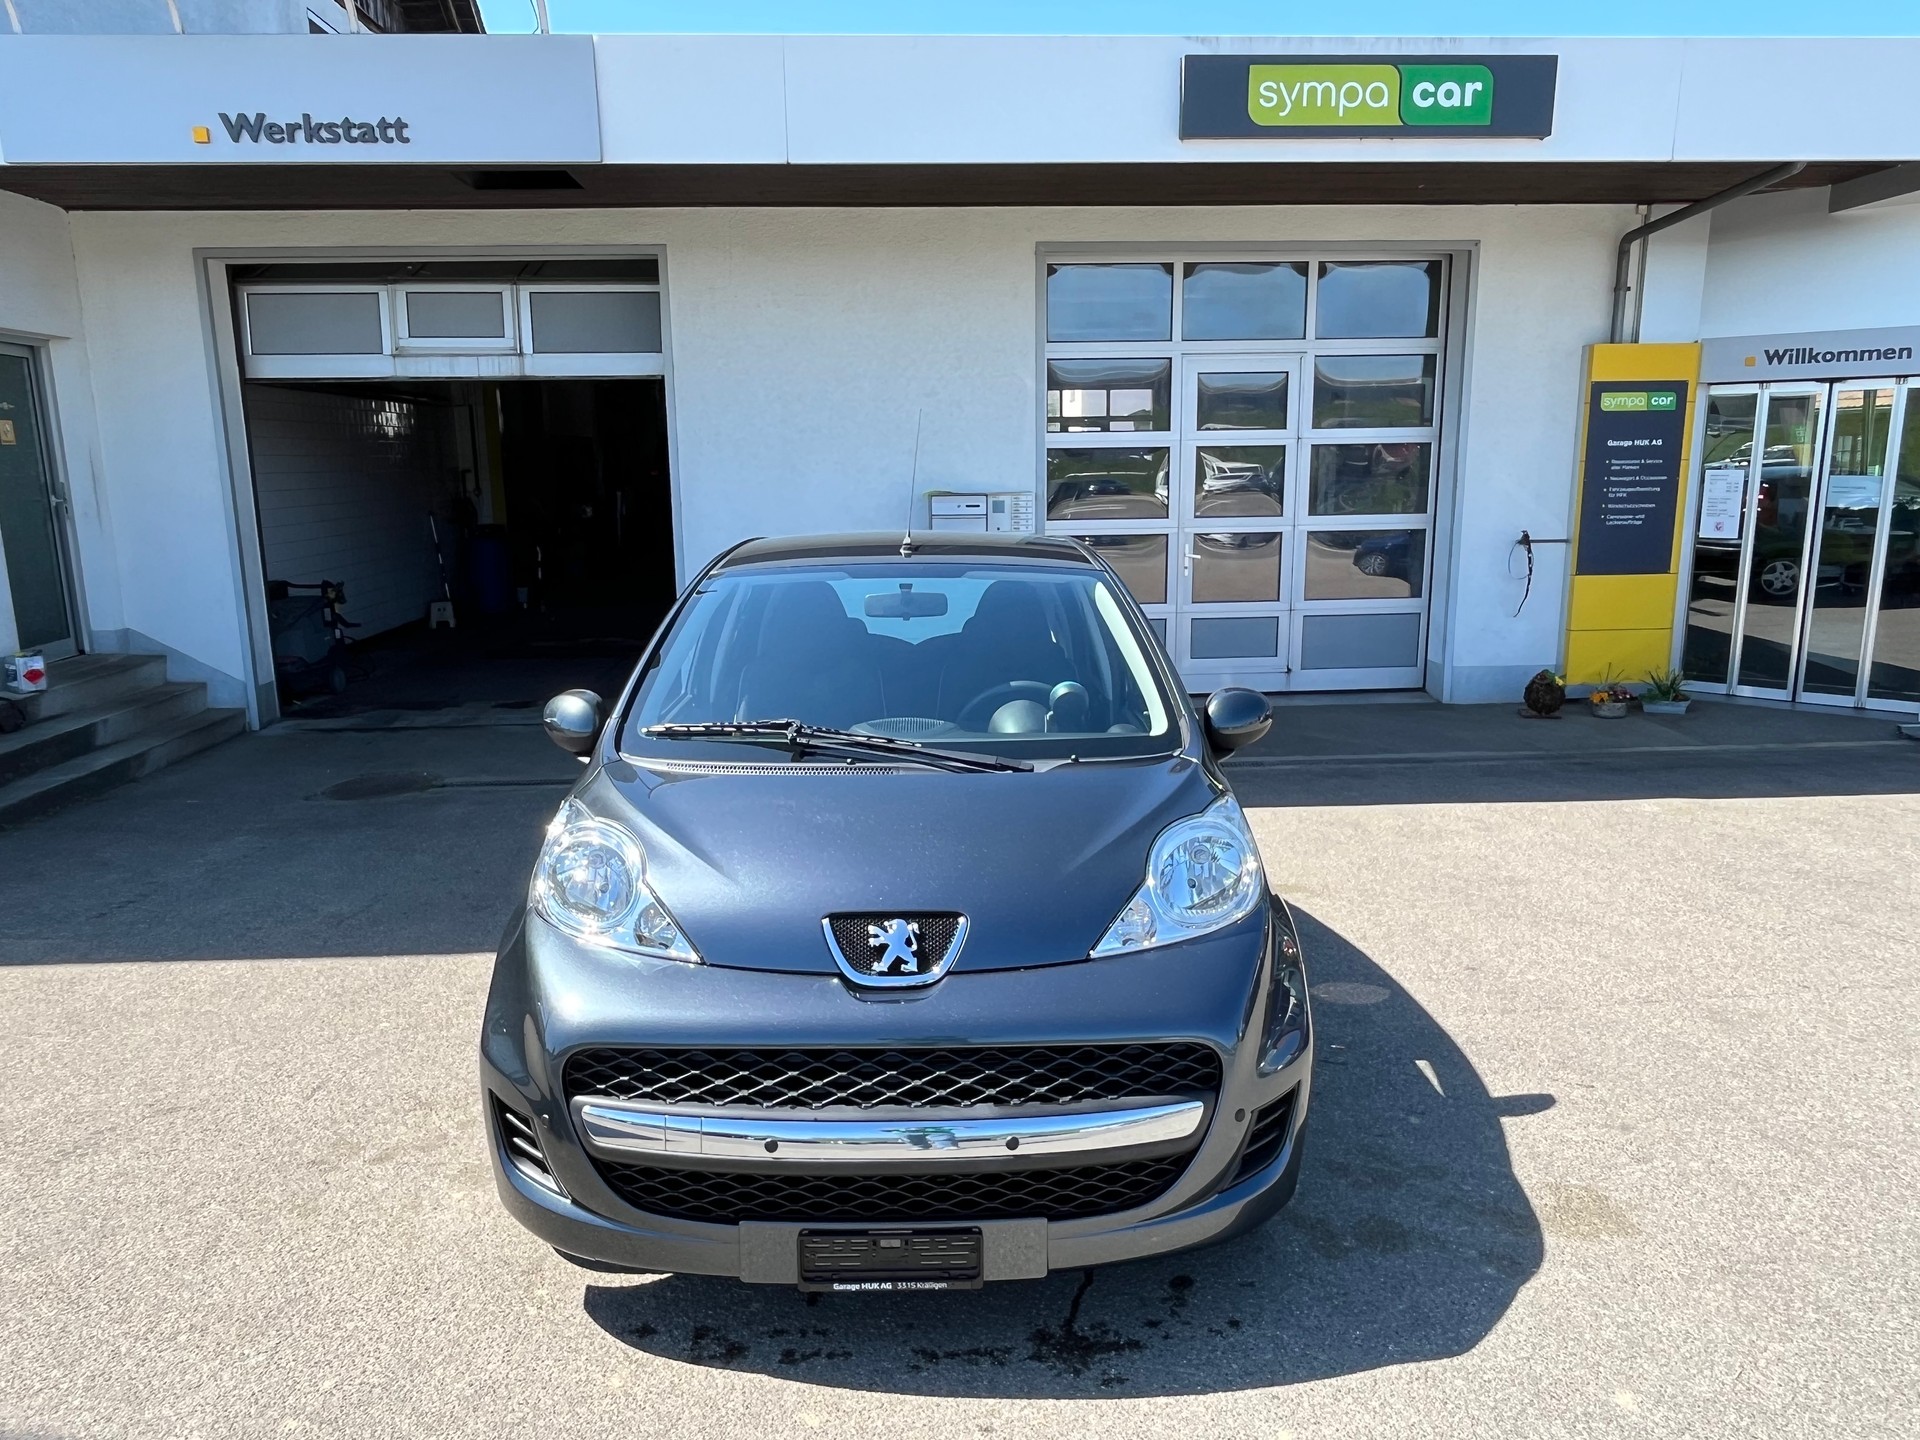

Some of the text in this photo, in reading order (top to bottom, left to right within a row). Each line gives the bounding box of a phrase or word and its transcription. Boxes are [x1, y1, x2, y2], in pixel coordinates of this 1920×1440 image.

[1258, 80, 1483, 117] sympa car
[217, 112, 410, 144] Werkstatt
[1764, 346, 1912, 366] Willkommen
[1603, 396, 1673, 408] sympa car
[833, 1283, 860, 1291] Garage
[880, 1282, 892, 1290] AG
